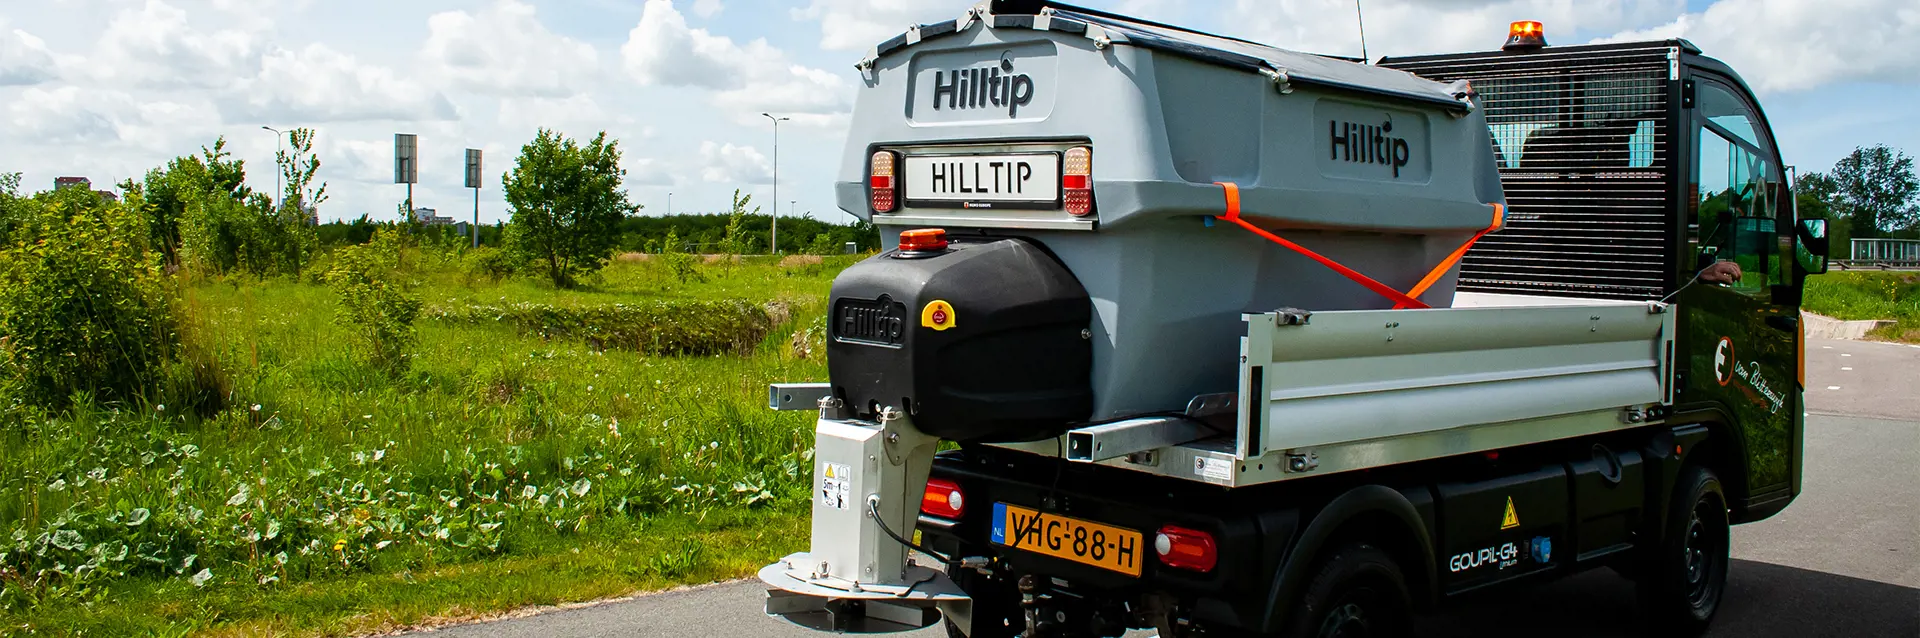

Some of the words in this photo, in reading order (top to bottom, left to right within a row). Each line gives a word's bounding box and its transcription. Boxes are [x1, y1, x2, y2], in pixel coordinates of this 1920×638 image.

[933, 54, 1034, 118] Hilltip
[1329, 116, 1409, 178] Hilltip
[932, 161, 1032, 193] HILLTIP
[843, 303, 903, 344] Hilltip
[993, 527, 1003, 537] NL
